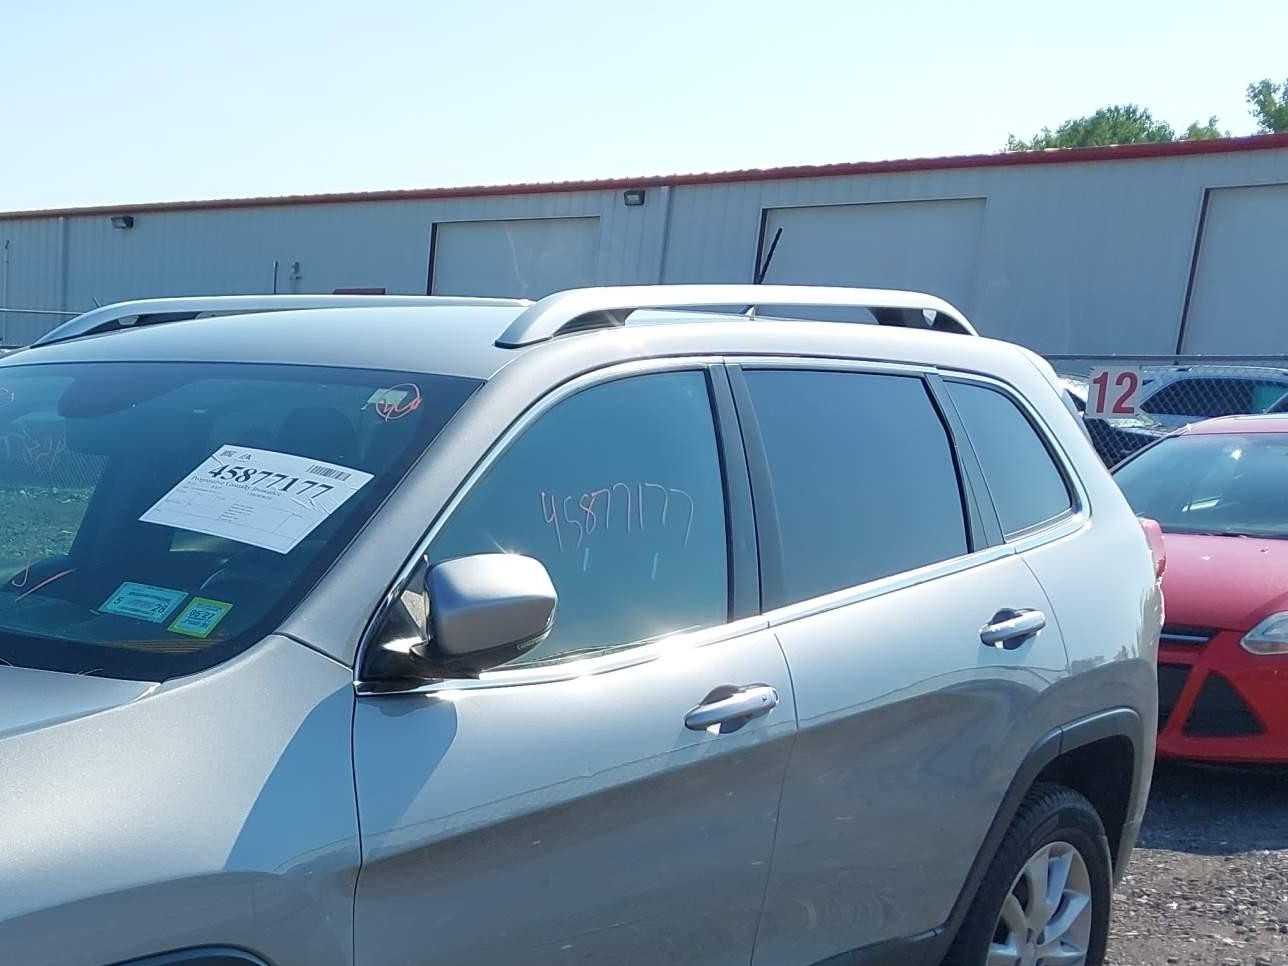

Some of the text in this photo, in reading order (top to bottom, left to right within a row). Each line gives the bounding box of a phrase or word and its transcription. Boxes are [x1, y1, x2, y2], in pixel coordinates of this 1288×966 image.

[1091, 371, 1139, 414] 12
[207, 464, 335, 499] 45877177
[540, 481, 695, 553] 45877177
[113, 596, 124, 605] 5
[152, 602, 168, 614] 28
